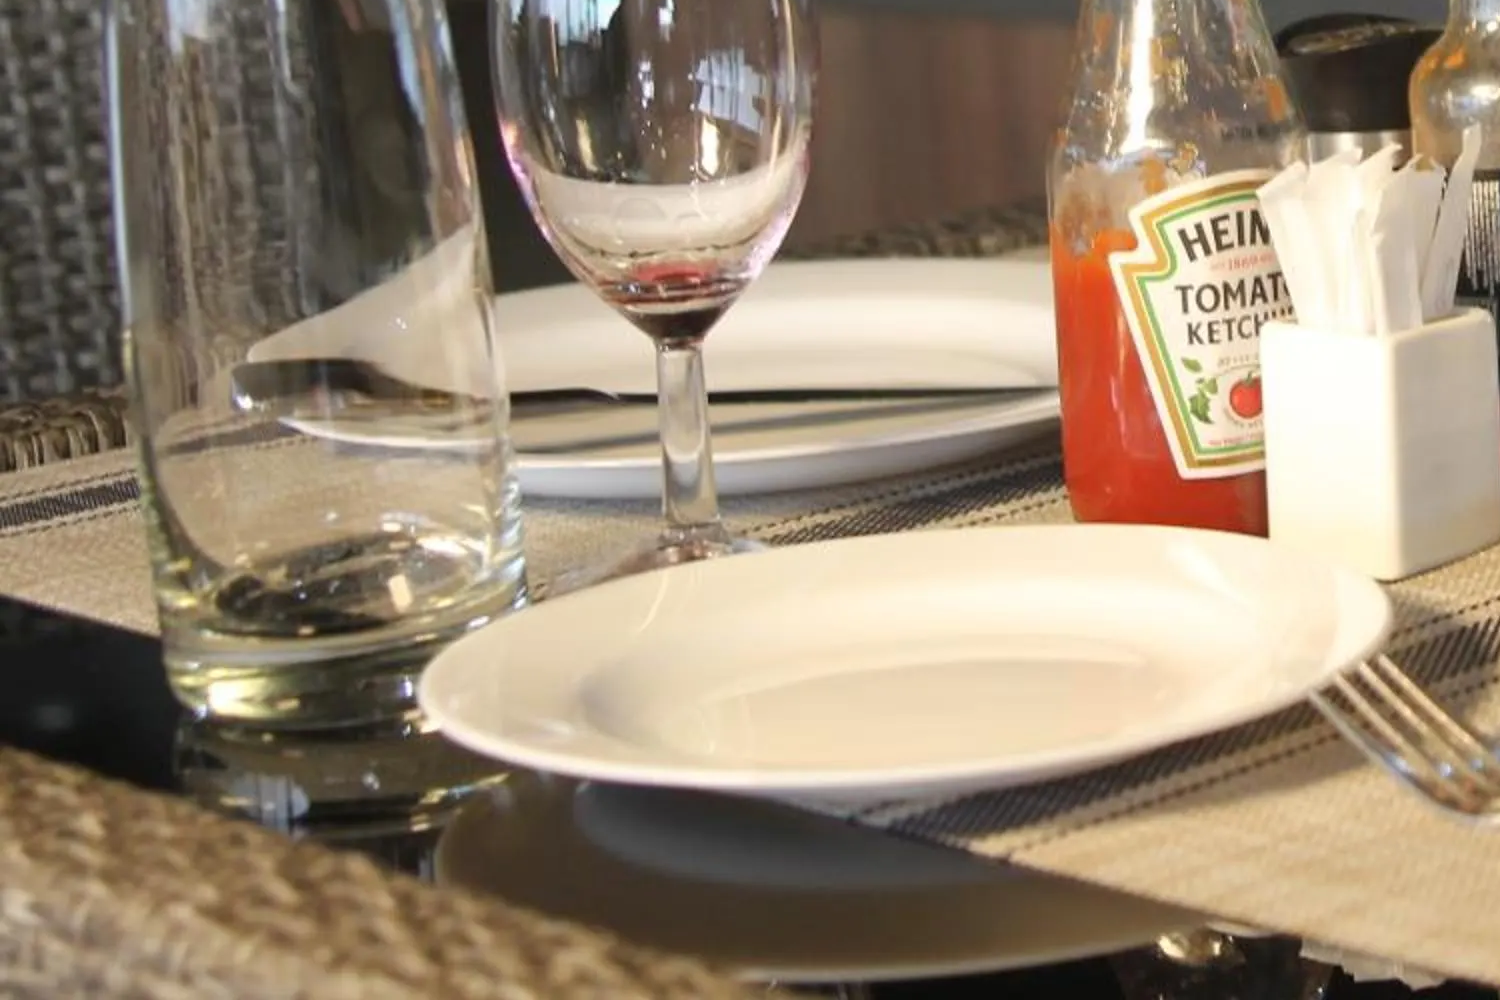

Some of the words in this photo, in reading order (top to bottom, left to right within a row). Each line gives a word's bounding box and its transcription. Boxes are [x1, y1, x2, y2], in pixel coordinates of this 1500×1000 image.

[1177, 208, 1270, 263] HEIN
[1174, 271, 1291, 315] TOMAT
[1186, 304, 1294, 345] KETCH
